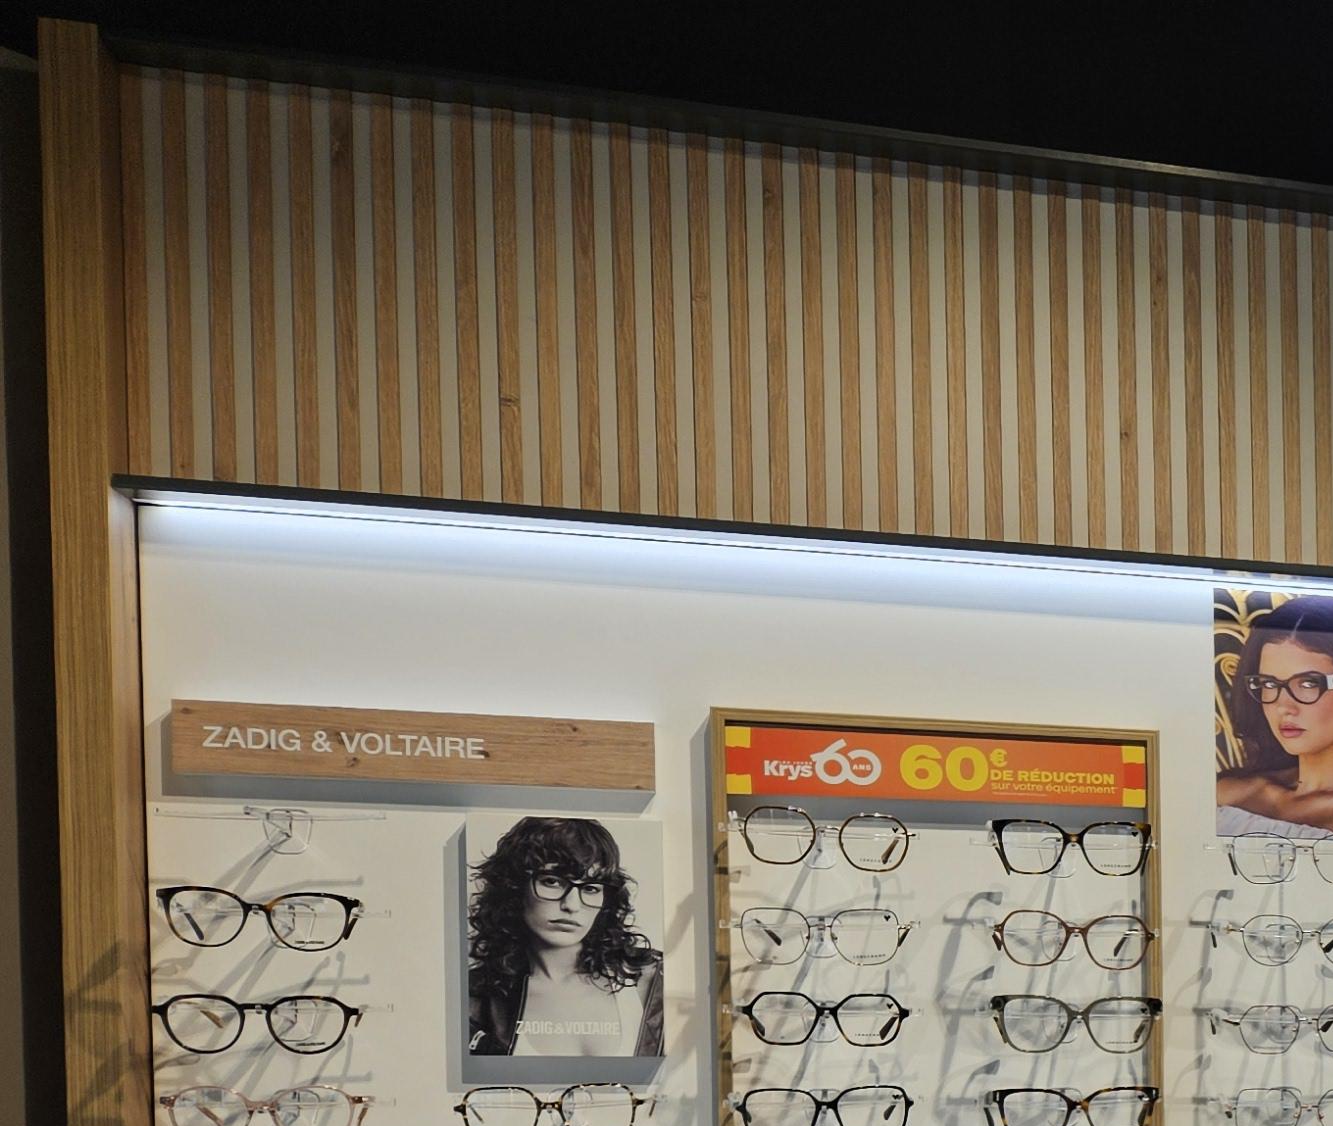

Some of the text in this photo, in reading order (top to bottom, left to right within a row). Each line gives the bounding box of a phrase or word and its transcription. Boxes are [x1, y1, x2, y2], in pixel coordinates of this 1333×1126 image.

[202, 725, 486, 760] ZADIG & VOLTAIRE
[764, 760, 813, 780] Krys
[810, 738, 882, 786] 60
[990, 768, 1115, 785] DE RÉDUCTION
[991, 782, 1116, 794] sur votre équipement
[515, 1020, 621, 1037] ZADIG&VOLTAIRE
